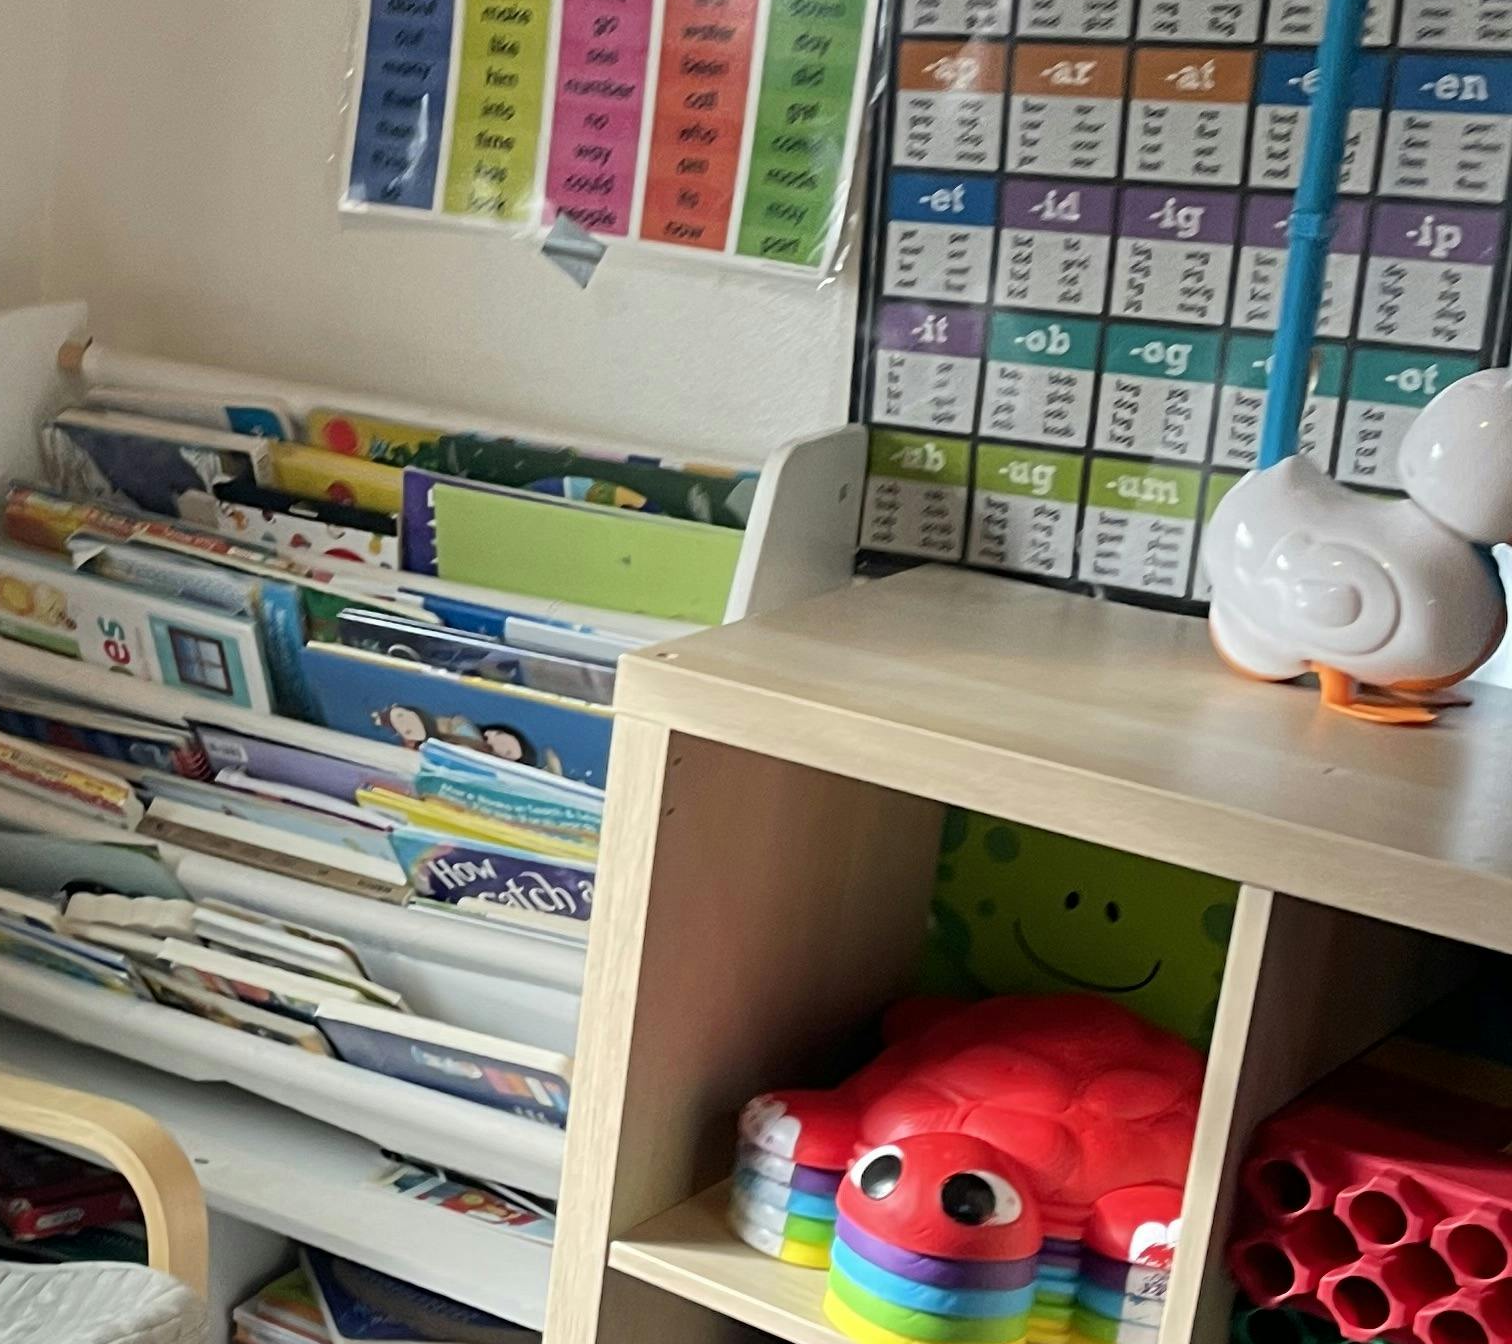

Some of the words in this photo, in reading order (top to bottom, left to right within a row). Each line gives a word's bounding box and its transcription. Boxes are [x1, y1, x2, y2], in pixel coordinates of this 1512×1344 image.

[1162, 60, 1218, 92] -at
[1287, 67, 1323, 93] -e
[1418, 70, 1488, 103] -en
[918, 183, 966, 215] -et
[1028, 189, 1082, 224] -id
[1147, 196, 1206, 240] -ig
[1404, 213, 1464, 259] -ip
[910, 313, 951, 346] -it
[1013, 324, 1072, 357] -ob
[1127, 340, 1195, 378] -og
[1384, 364, 1440, 395] -ot
[996, 458, 1058, 497] -ug
[427, 856, 499, 892] How
